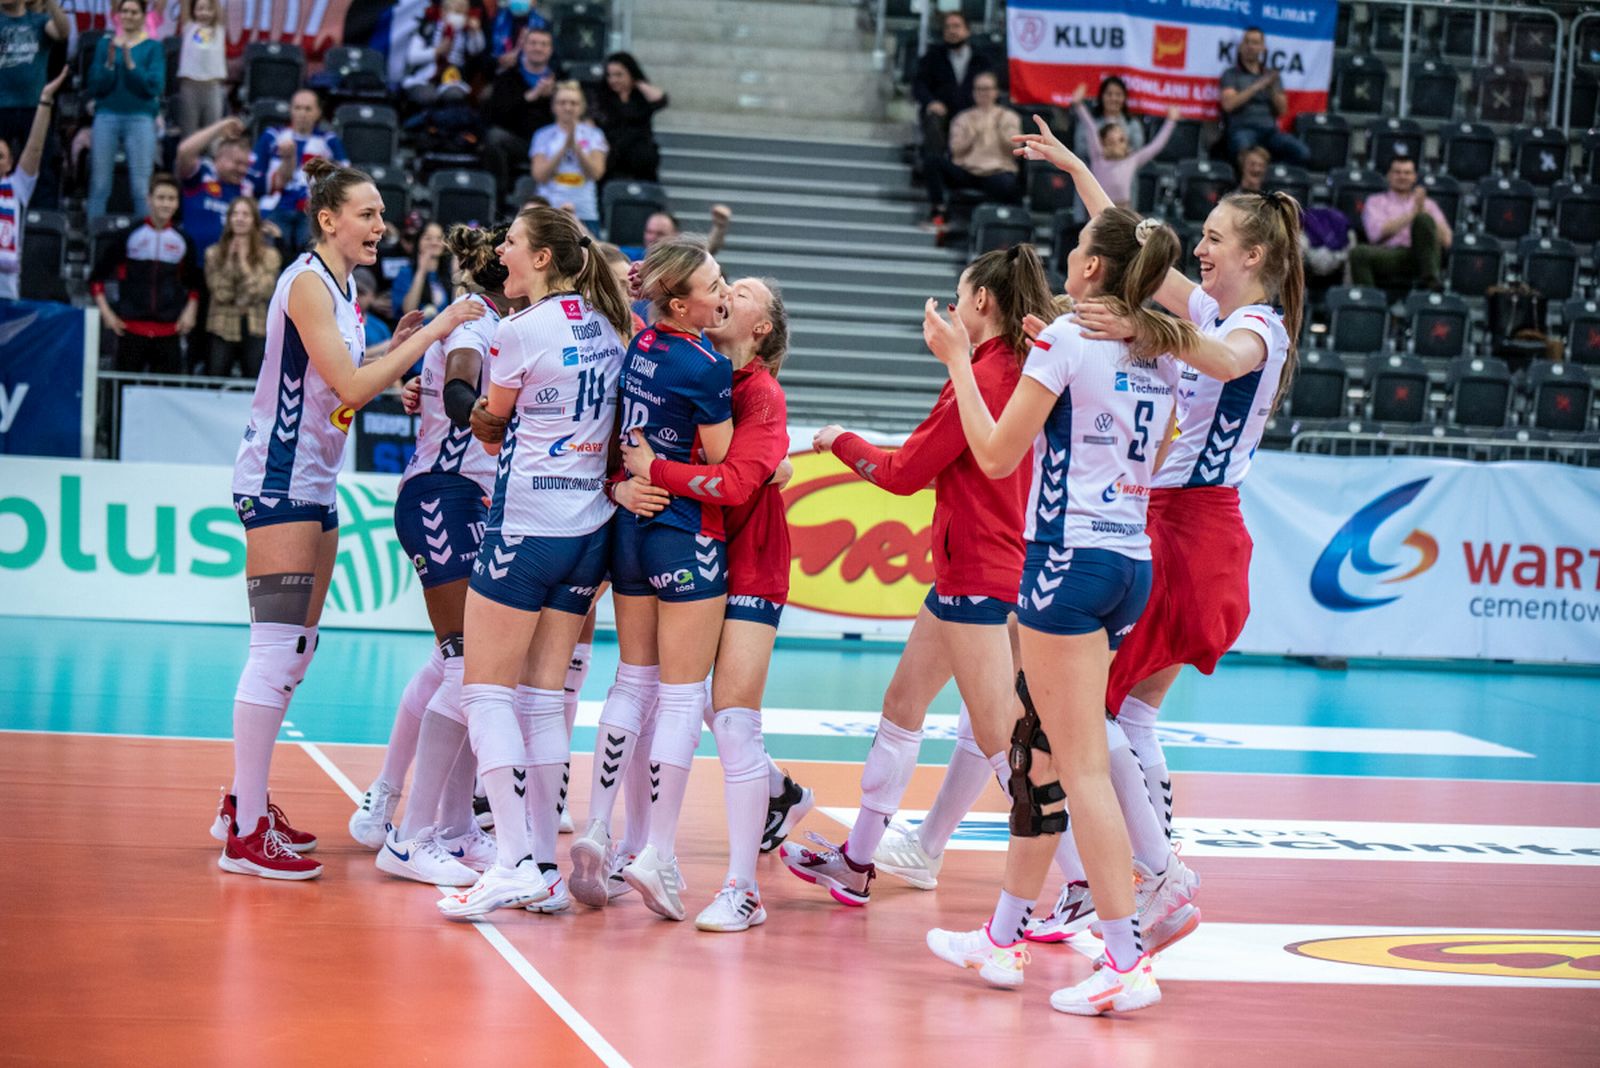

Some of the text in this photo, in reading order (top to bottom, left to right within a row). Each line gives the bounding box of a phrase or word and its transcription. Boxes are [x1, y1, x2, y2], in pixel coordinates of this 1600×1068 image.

[1054, 26, 1125, 49] KLUB
[580, 347, 619, 363] Technitel
[572, 367, 605, 421] 14
[1127, 400, 1154, 463] 5
